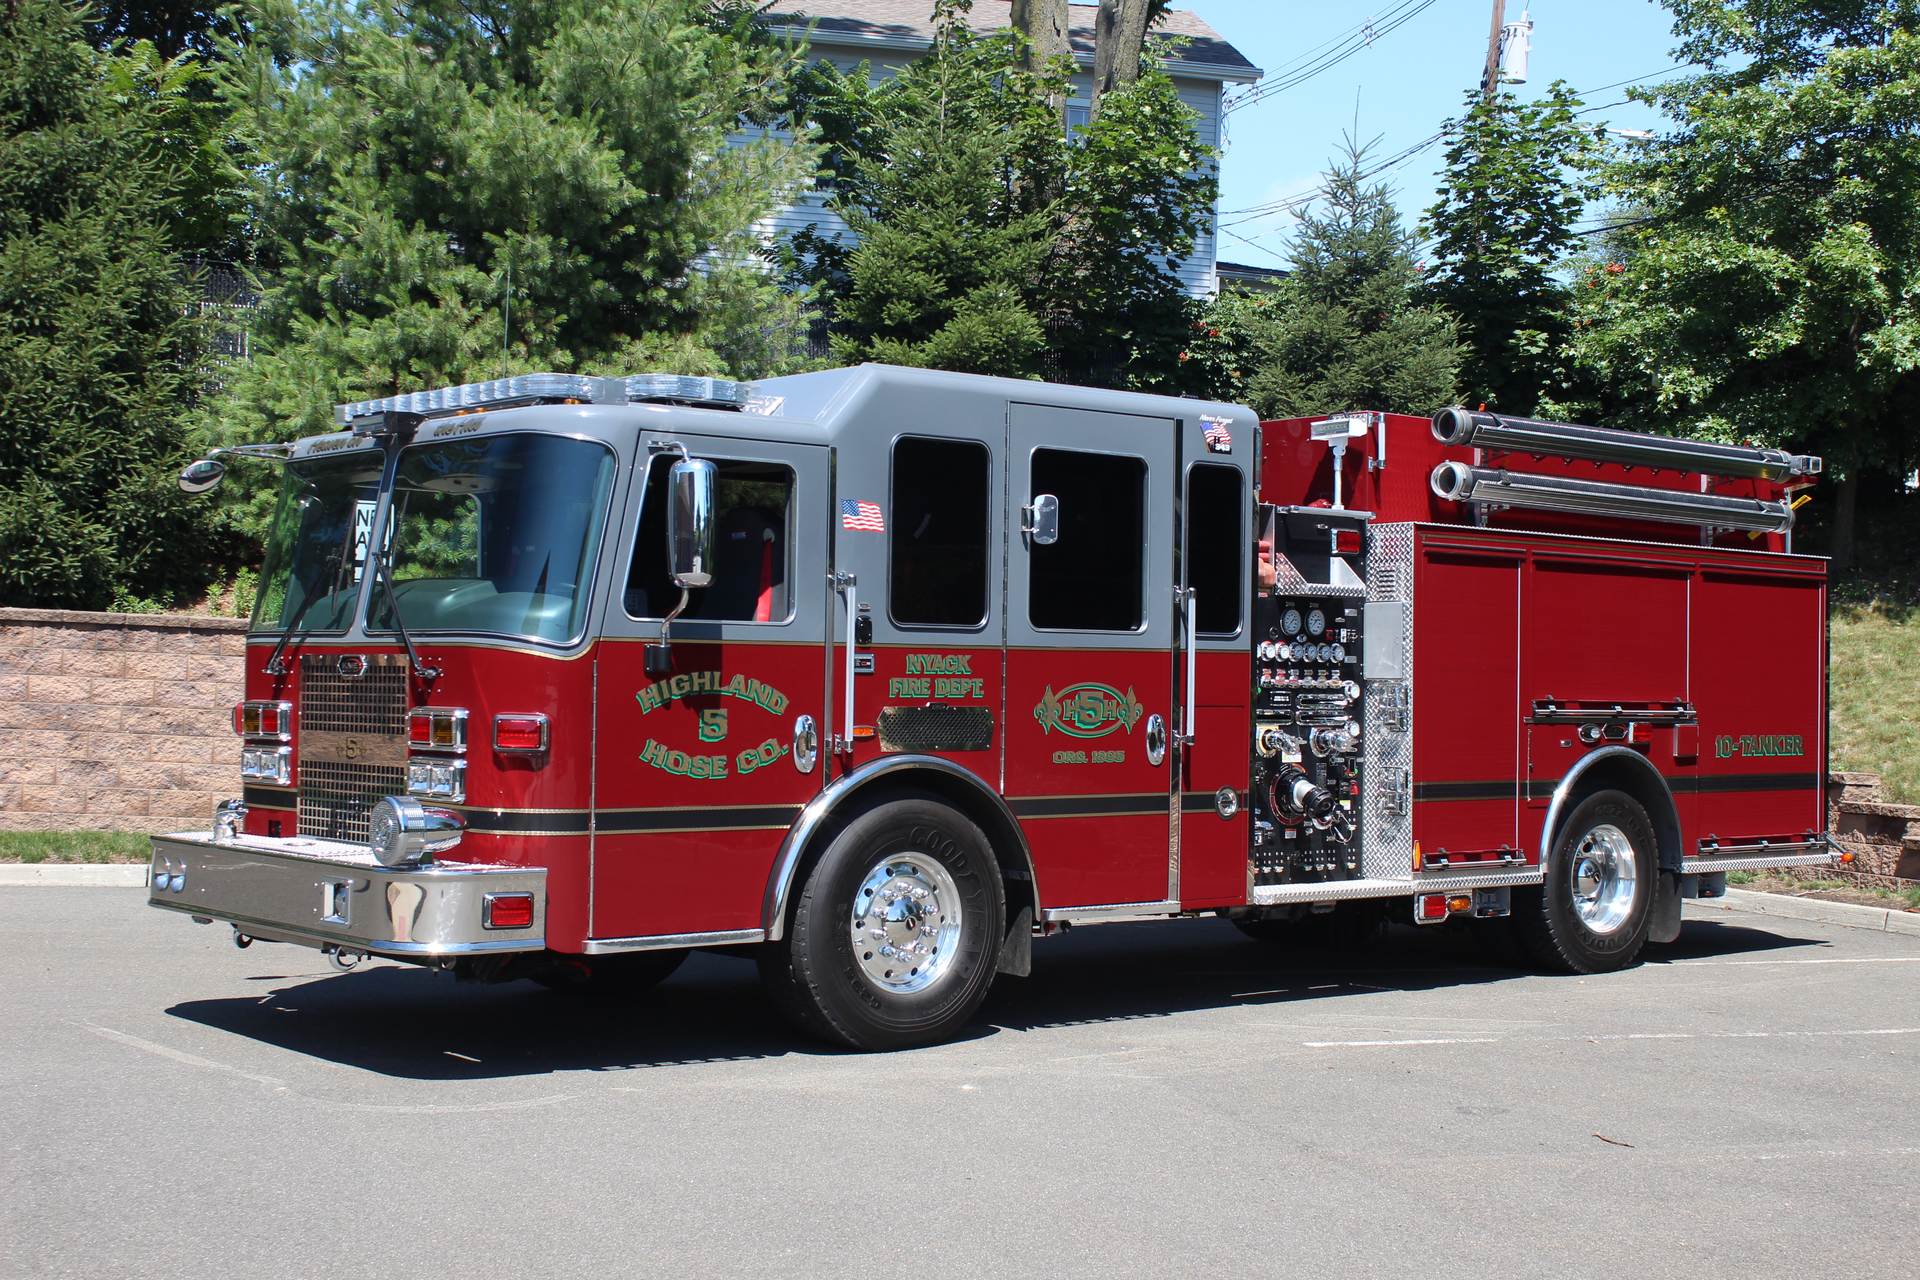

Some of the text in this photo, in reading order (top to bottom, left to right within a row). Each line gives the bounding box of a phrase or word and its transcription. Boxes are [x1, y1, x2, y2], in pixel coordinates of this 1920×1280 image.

[1215, 443, 1230, 452] 343
[905, 654, 972, 674] NYACK
[635, 671, 790, 715] HIGHLAND
[889, 678, 985, 698] FIRE DEPT.
[698, 708, 728, 742] 5
[345, 736, 358, 759] 5
[1053, 750, 1125, 764] ORG. 1895
[1715, 734, 1804, 758] 10-TANKER
[638, 738, 789, 779] HOSE CO.
[908, 825, 986, 980] GOODYEAR
